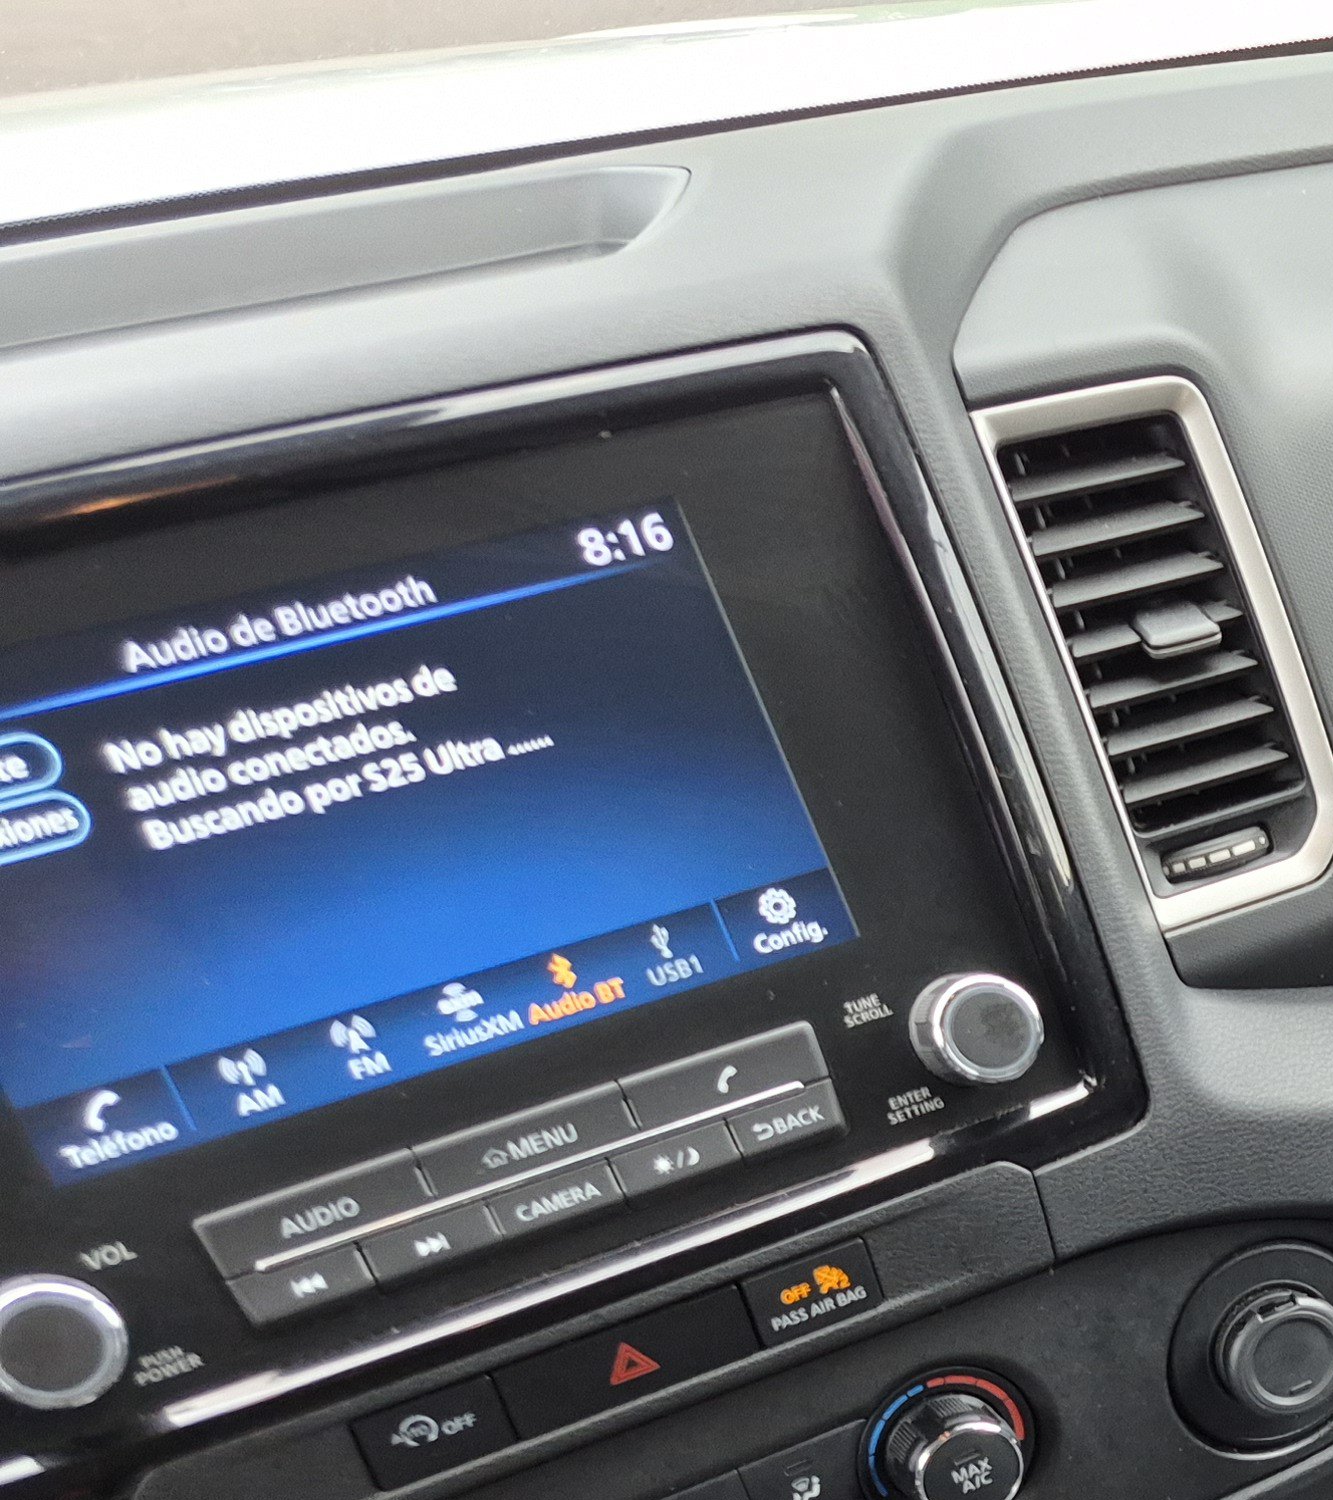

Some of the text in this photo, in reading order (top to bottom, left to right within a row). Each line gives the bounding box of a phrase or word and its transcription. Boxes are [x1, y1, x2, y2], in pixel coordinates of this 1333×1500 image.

[577, 511, 674, 566] 8:16
[121, 575, 438, 673] Audio de Bluetooth
[103, 664, 458, 774] No hay dispositivos de
[126, 720, 417, 812] audio conectados.
[142, 788, 305, 850] Buscando
[304, 773, 362, 814] por
[362, 753, 426, 793] S25
[423, 737, 506, 775] Ultra
[753, 920, 829, 954] Config.
[646, 954, 704, 986] USB1
[528, 976, 627, 1026] Audio BT
[843, 993, 881, 1014] TUNE
[844, 1004, 894, 1028] SCROLL
[424, 1010, 525, 1057] SiriusXM
[348, 1052, 393, 1080] FM
[238, 1084, 287, 1117] AM
[887, 1097, 945, 1126] SETTING
[888, 1086, 932, 1111] ENTER
[772, 1105, 826, 1136] BACK
[59, 1122, 179, 1168] Teléfono
[507, 1123, 579, 1160] MENU
[280, 1196, 360, 1239] AUDIO
[516, 1182, 602, 1222] CAMERA
[80, 1241, 138, 1271] VOL
[771, 1285, 867, 1332] PASS AIR BAG
[780, 1282, 812, 1305] OFF
[133, 1352, 205, 1386] POWER
[441, 1411, 477, 1435] OFF
[951, 1457, 992, 1484] MAX
[963, 1471, 993, 1494] A/C
